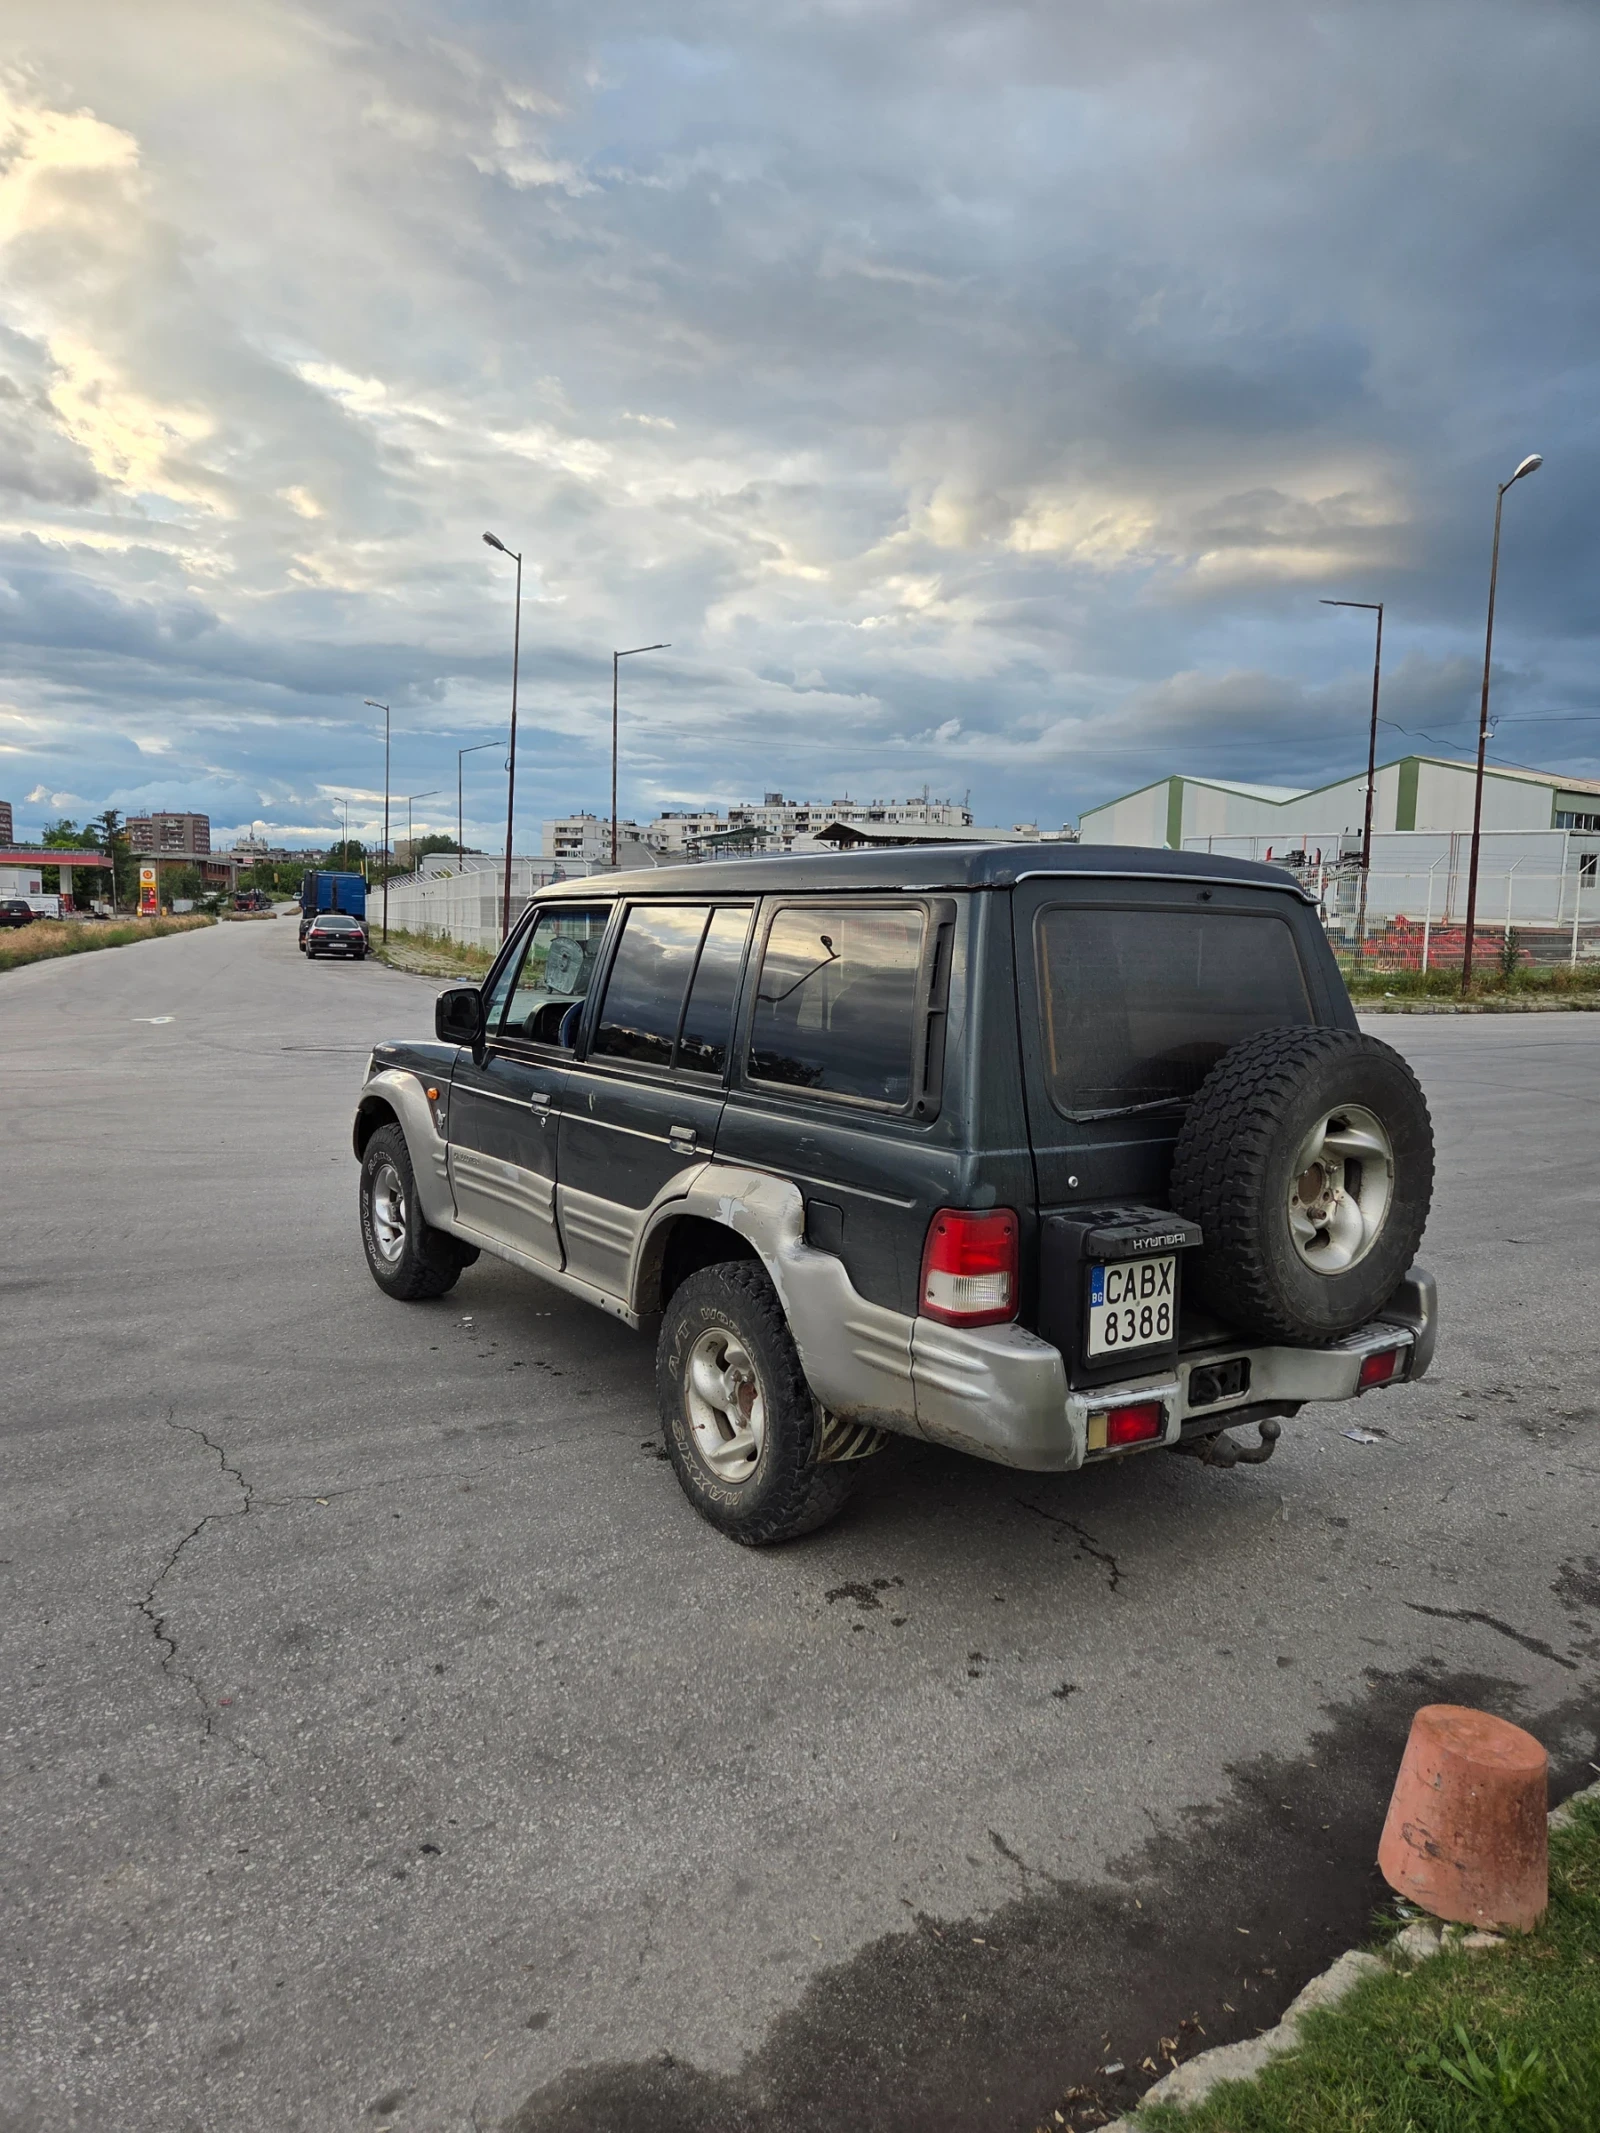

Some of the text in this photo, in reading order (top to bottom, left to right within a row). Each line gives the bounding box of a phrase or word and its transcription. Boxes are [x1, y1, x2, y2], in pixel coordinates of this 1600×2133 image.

[1133, 1233, 1186, 1250] HYUNDAI
[1092, 1292, 1103, 1304] BG
[1106, 1261, 1173, 1305] CABX
[1104, 1302, 1170, 1346] 8388
[672, 1419, 743, 1506] MAXXIS
